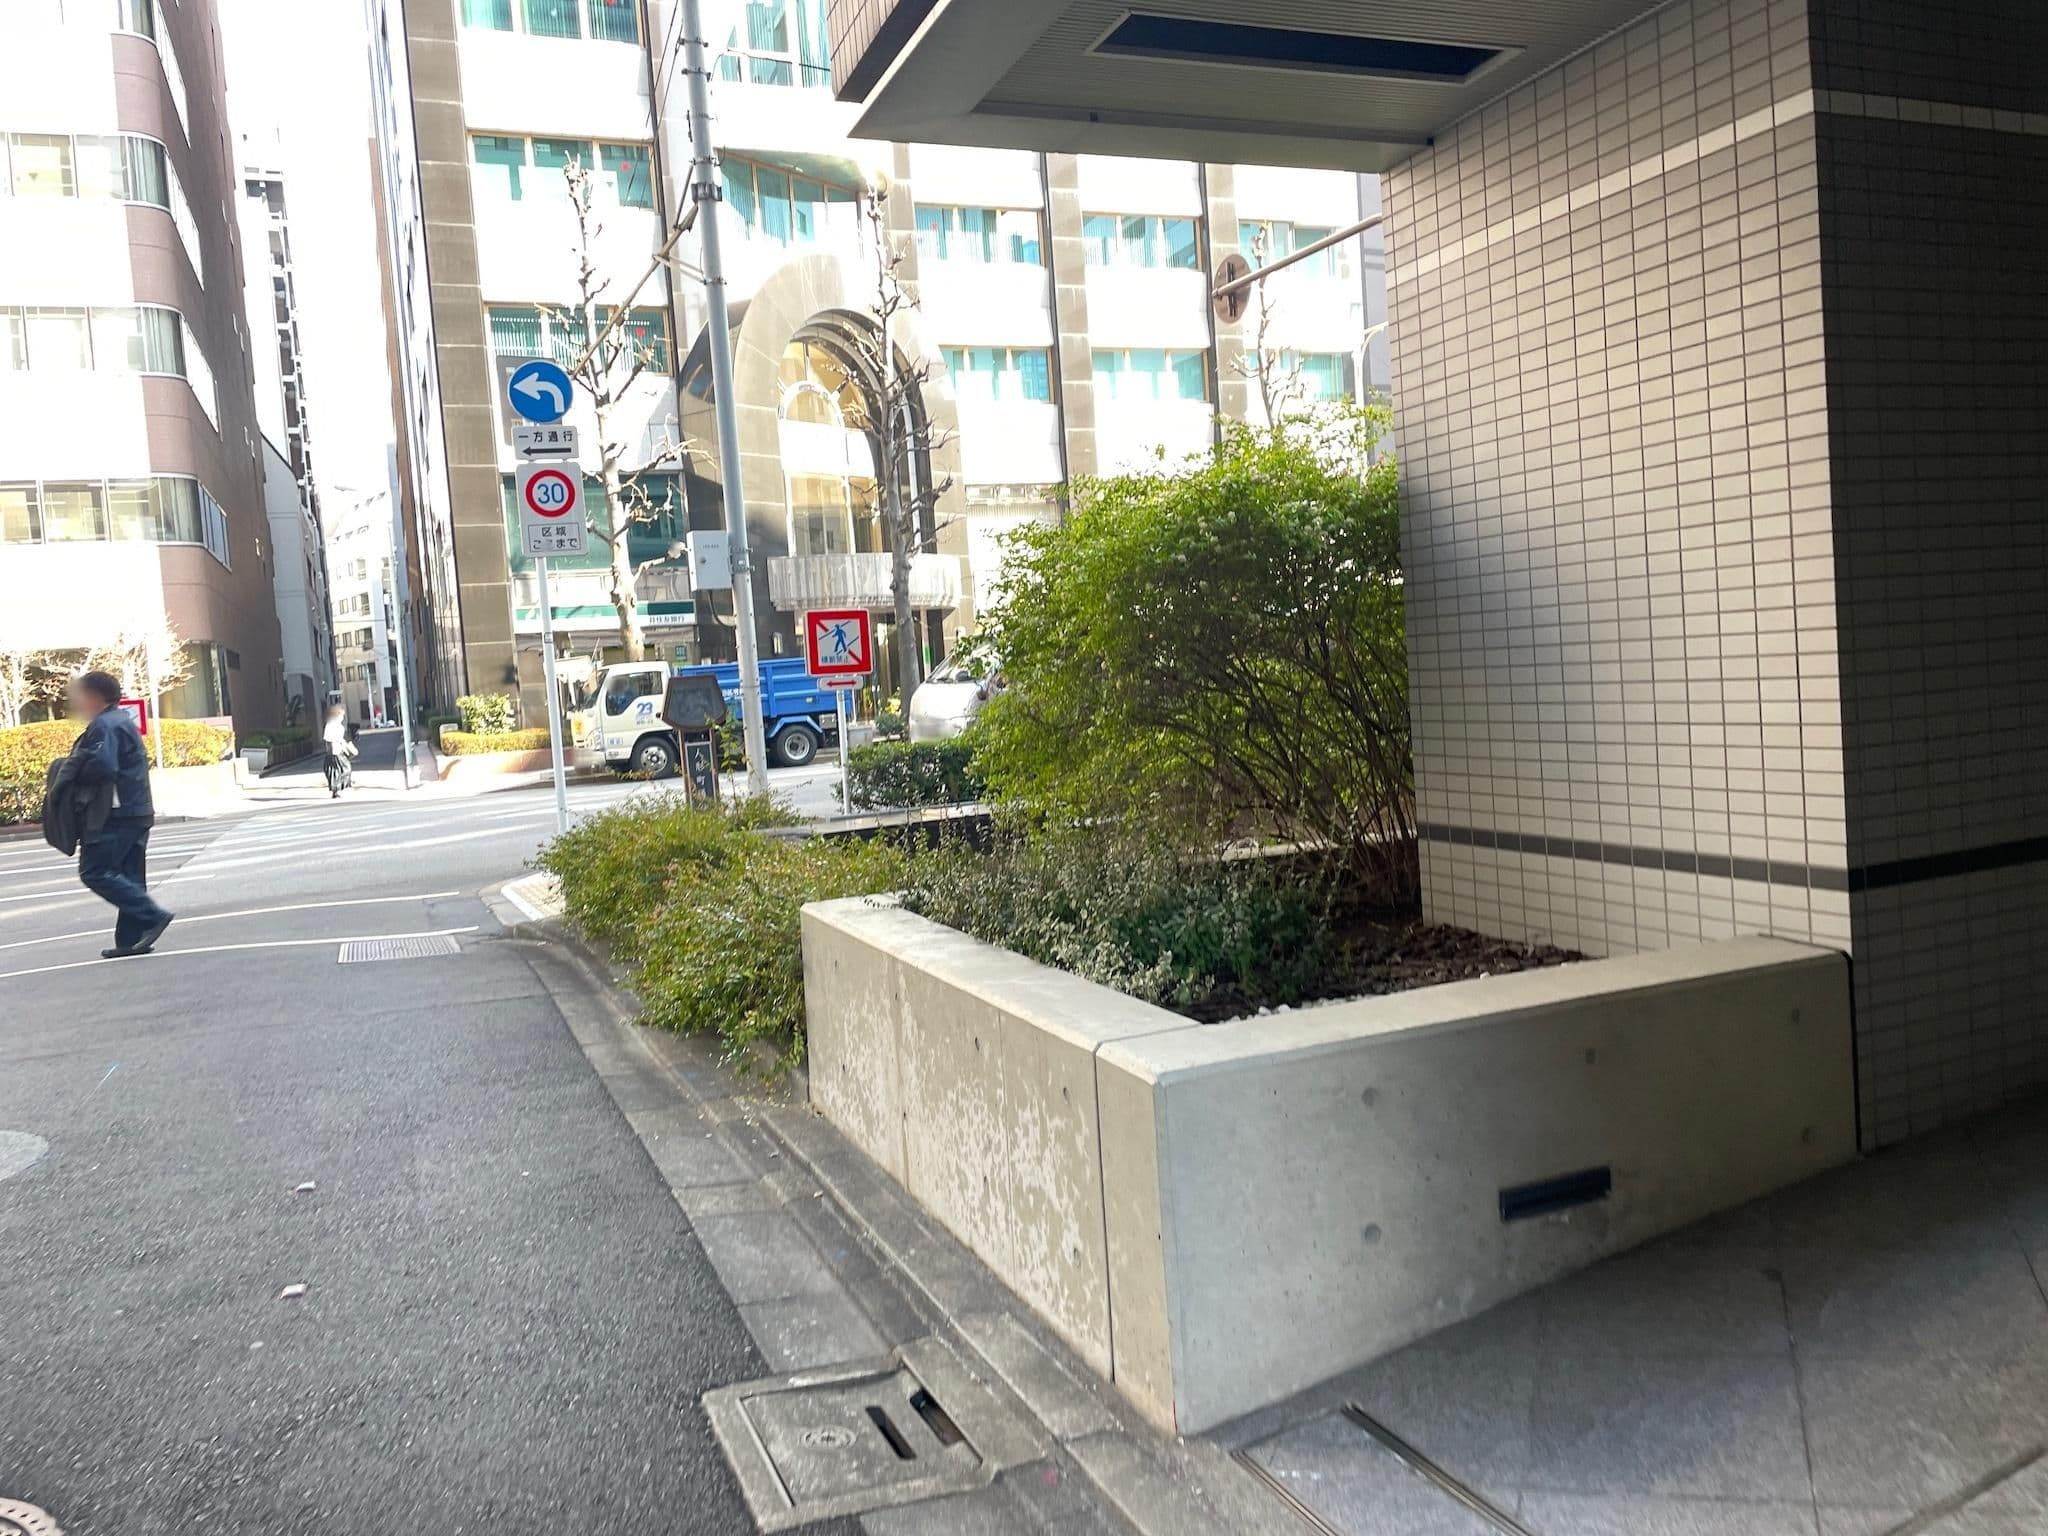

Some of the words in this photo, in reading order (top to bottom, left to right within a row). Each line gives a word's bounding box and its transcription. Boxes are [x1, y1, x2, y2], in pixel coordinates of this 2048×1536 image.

[518, 431, 573, 442] 一方通行
[537, 483, 565, 504] 30
[541, 527, 567, 538] 区域
[636, 702, 653, 714] 23
